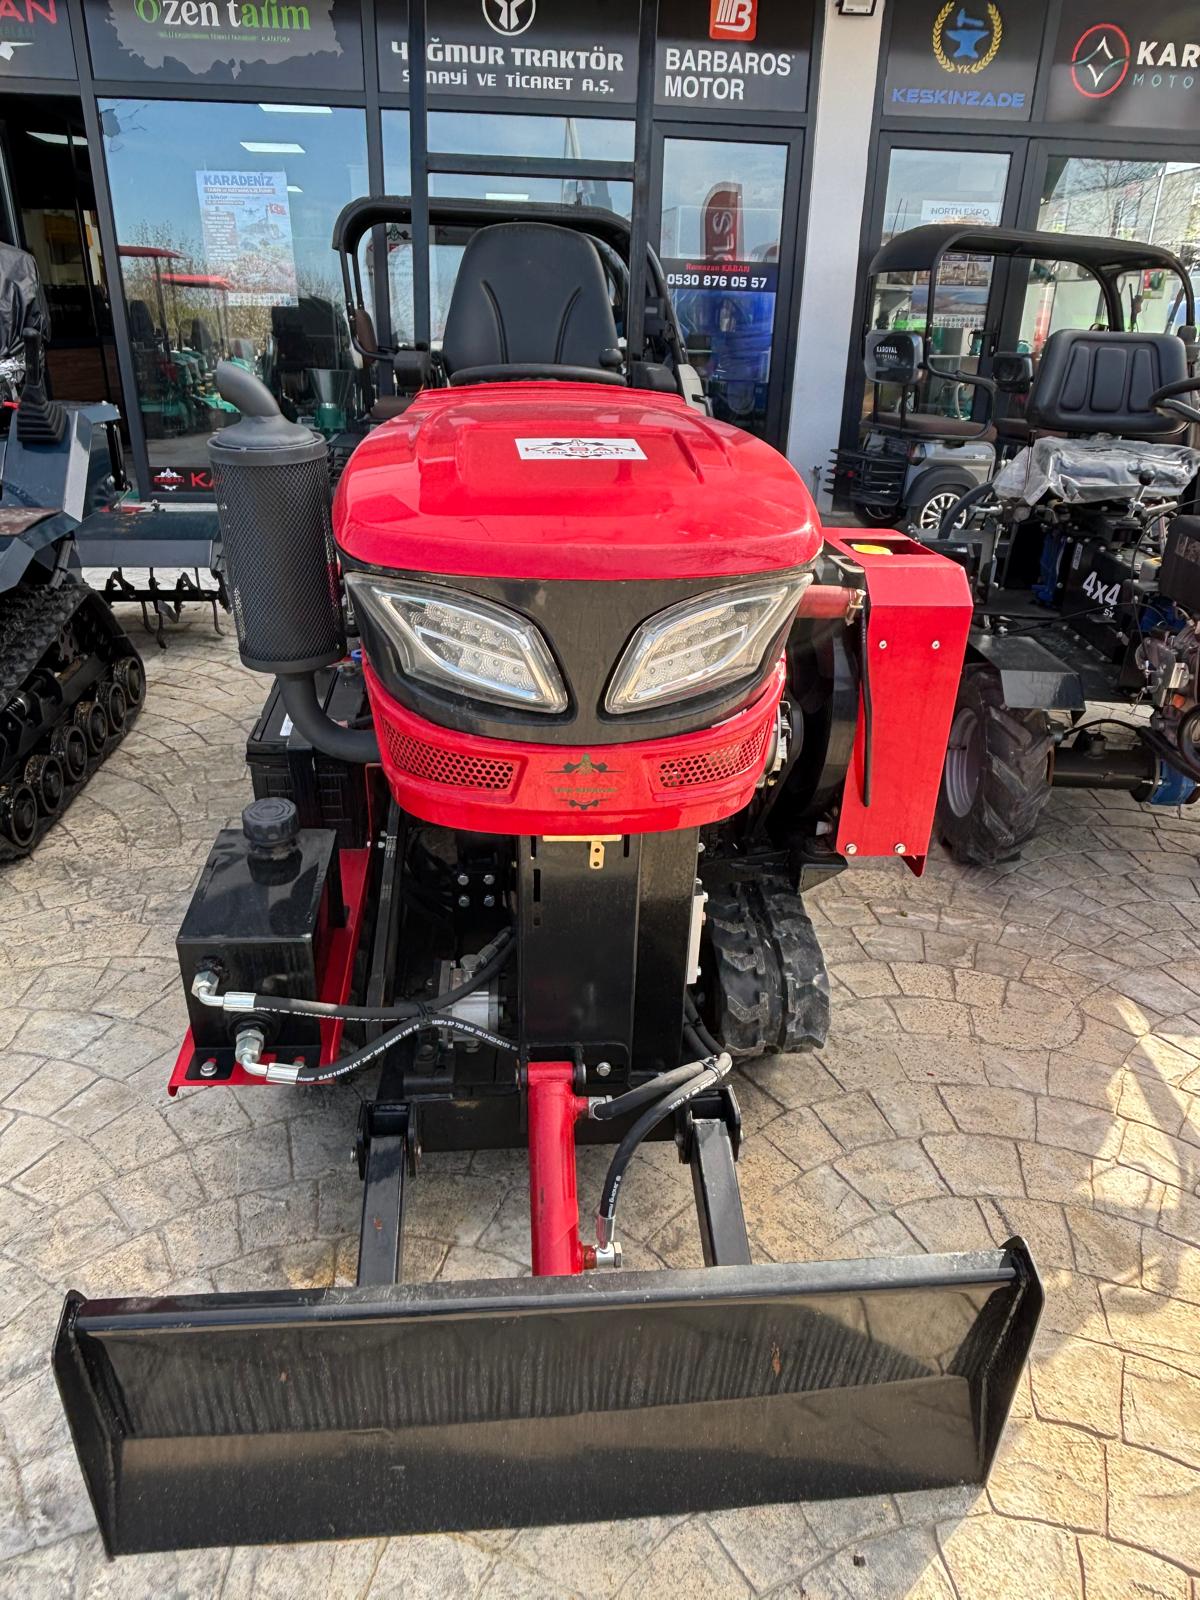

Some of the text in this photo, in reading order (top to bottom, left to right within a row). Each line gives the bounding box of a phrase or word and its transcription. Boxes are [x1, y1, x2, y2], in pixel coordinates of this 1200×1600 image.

[391, 37, 624, 71] YĞMUR TRAKTÖR
[665, 47, 792, 76] BARBAROS
[402, 69, 614, 94] SNAYİ VE TİCARET A.Ş.
[664, 75, 745, 100] MOTOR
[204, 173, 274, 186] KARADENİZ
[931, 207, 990, 217] NORTH EXPO
[667, 274, 768, 288] 0530 876 05 57
